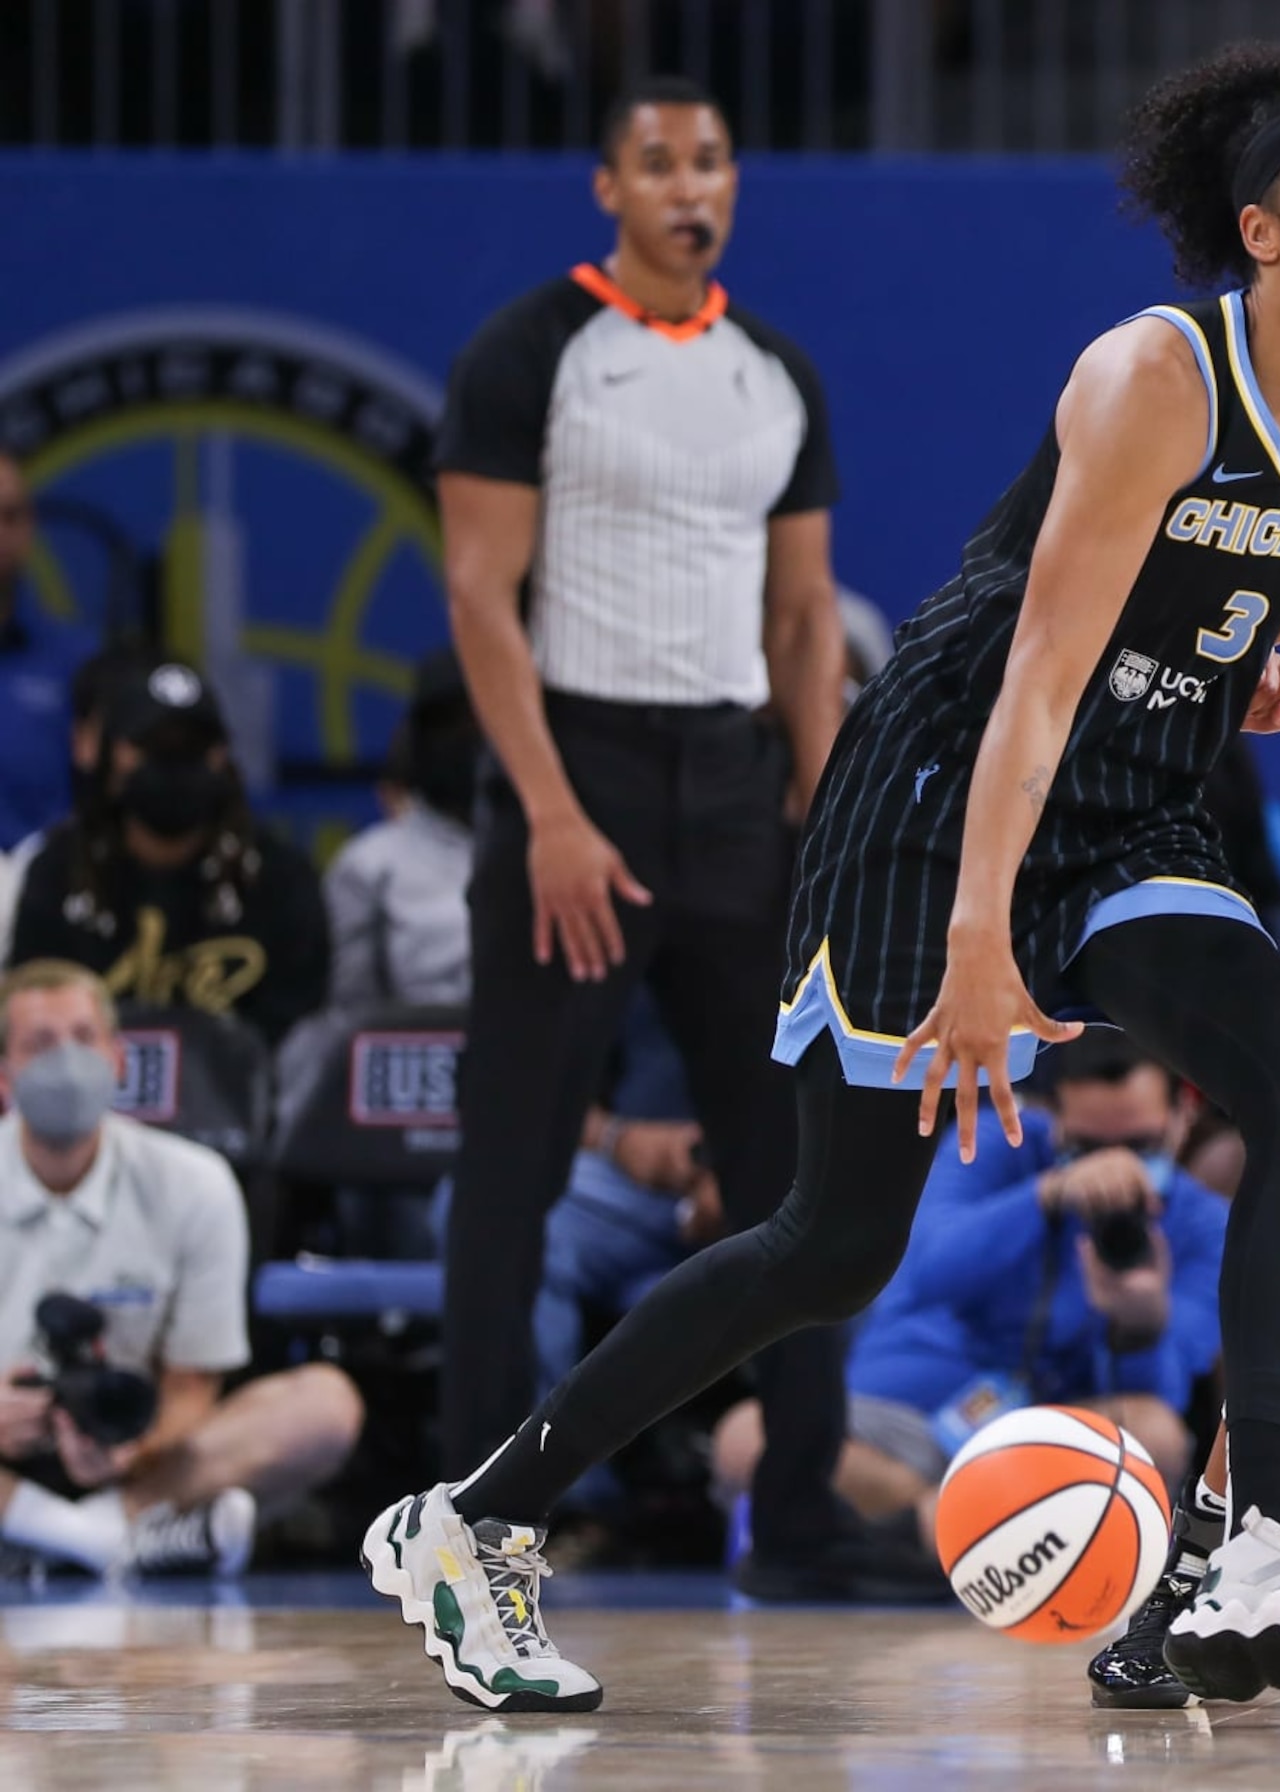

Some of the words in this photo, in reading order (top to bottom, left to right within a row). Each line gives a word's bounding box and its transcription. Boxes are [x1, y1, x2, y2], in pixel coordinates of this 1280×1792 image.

[1196, 589, 1269, 663] 3
[388, 1044, 456, 1113] US
[960, 1530, 1070, 1618] Wilson
